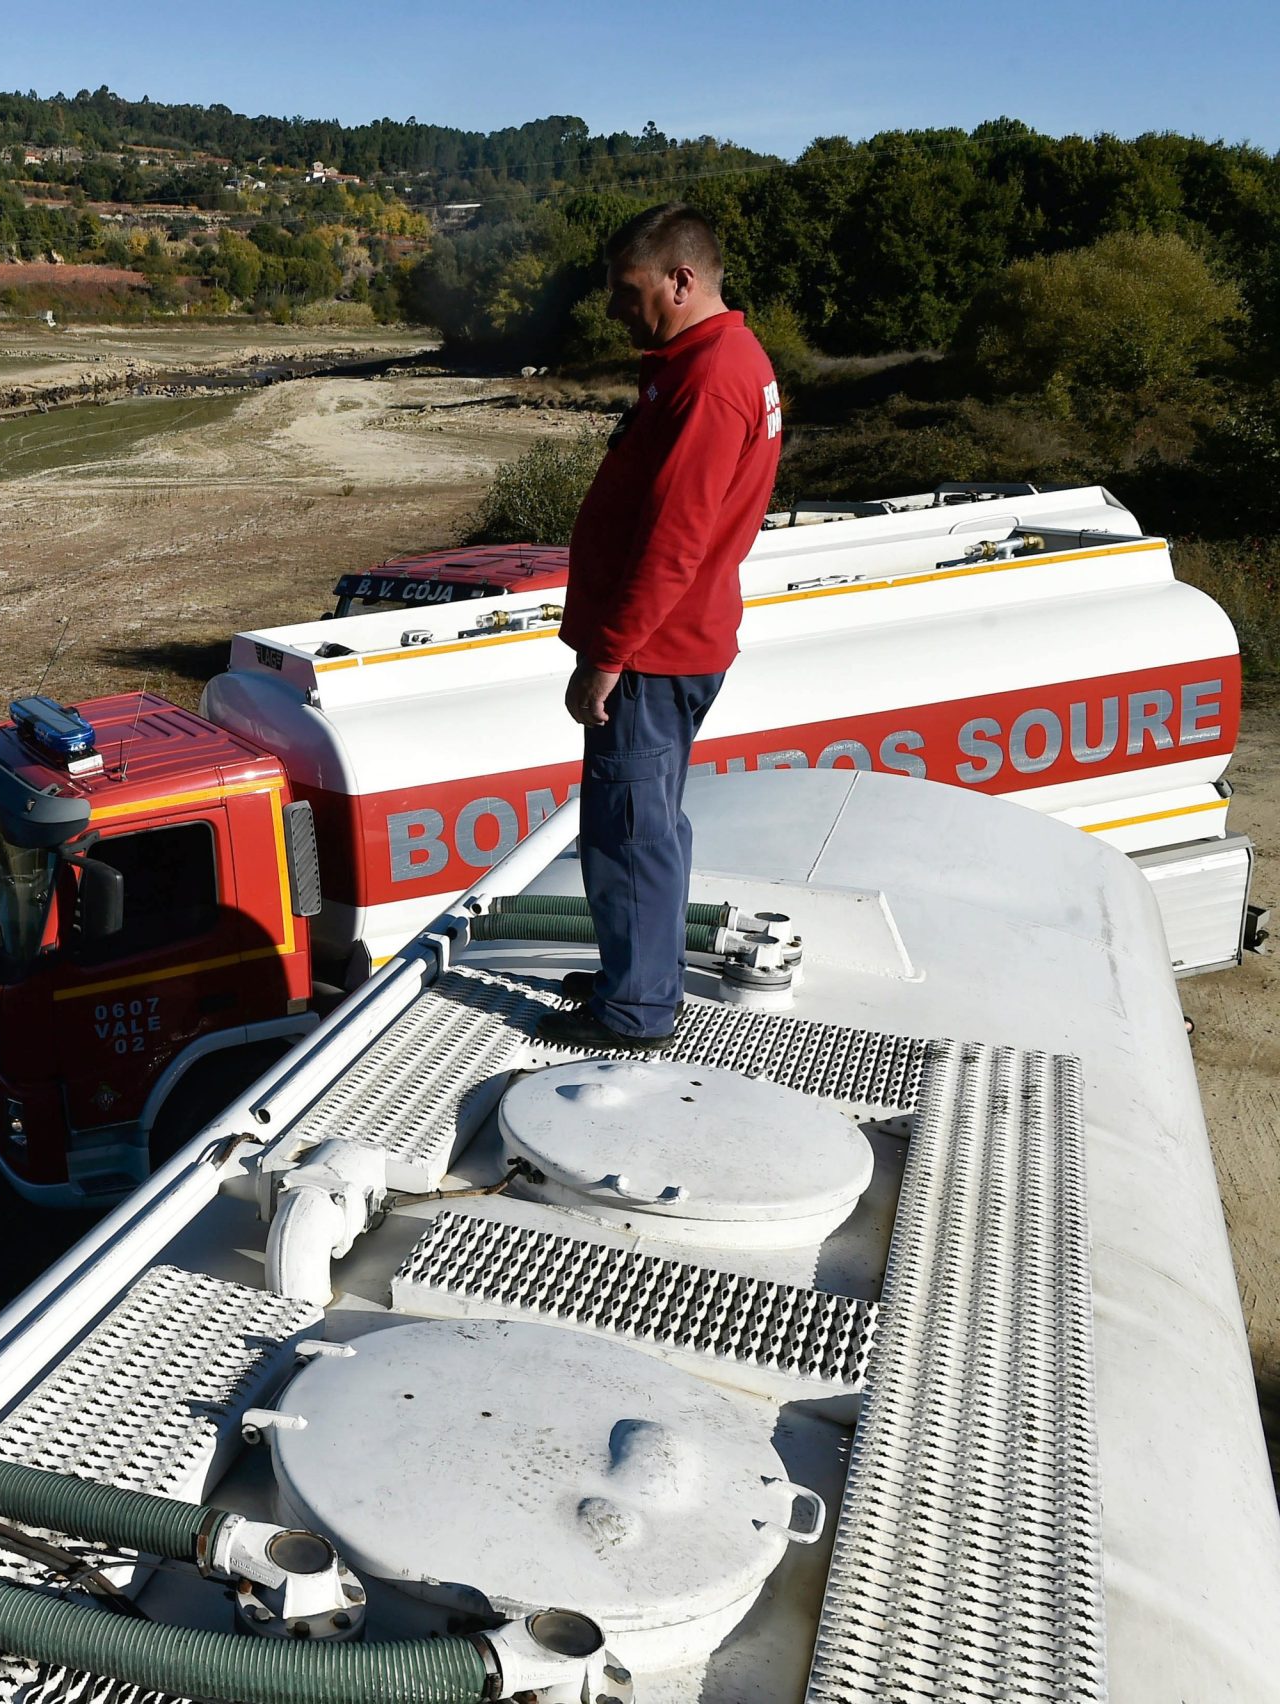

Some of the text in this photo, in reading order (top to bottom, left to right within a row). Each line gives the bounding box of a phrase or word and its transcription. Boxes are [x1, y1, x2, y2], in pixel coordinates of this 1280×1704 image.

[355, 578, 372, 596] B.
[379, 579, 395, 598] V.
[955, 678, 1223, 785] SOURE
[94, 996, 161, 1021] 0607
[94, 1015, 161, 1040] VALE
[114, 1036, 145, 1055] 02
